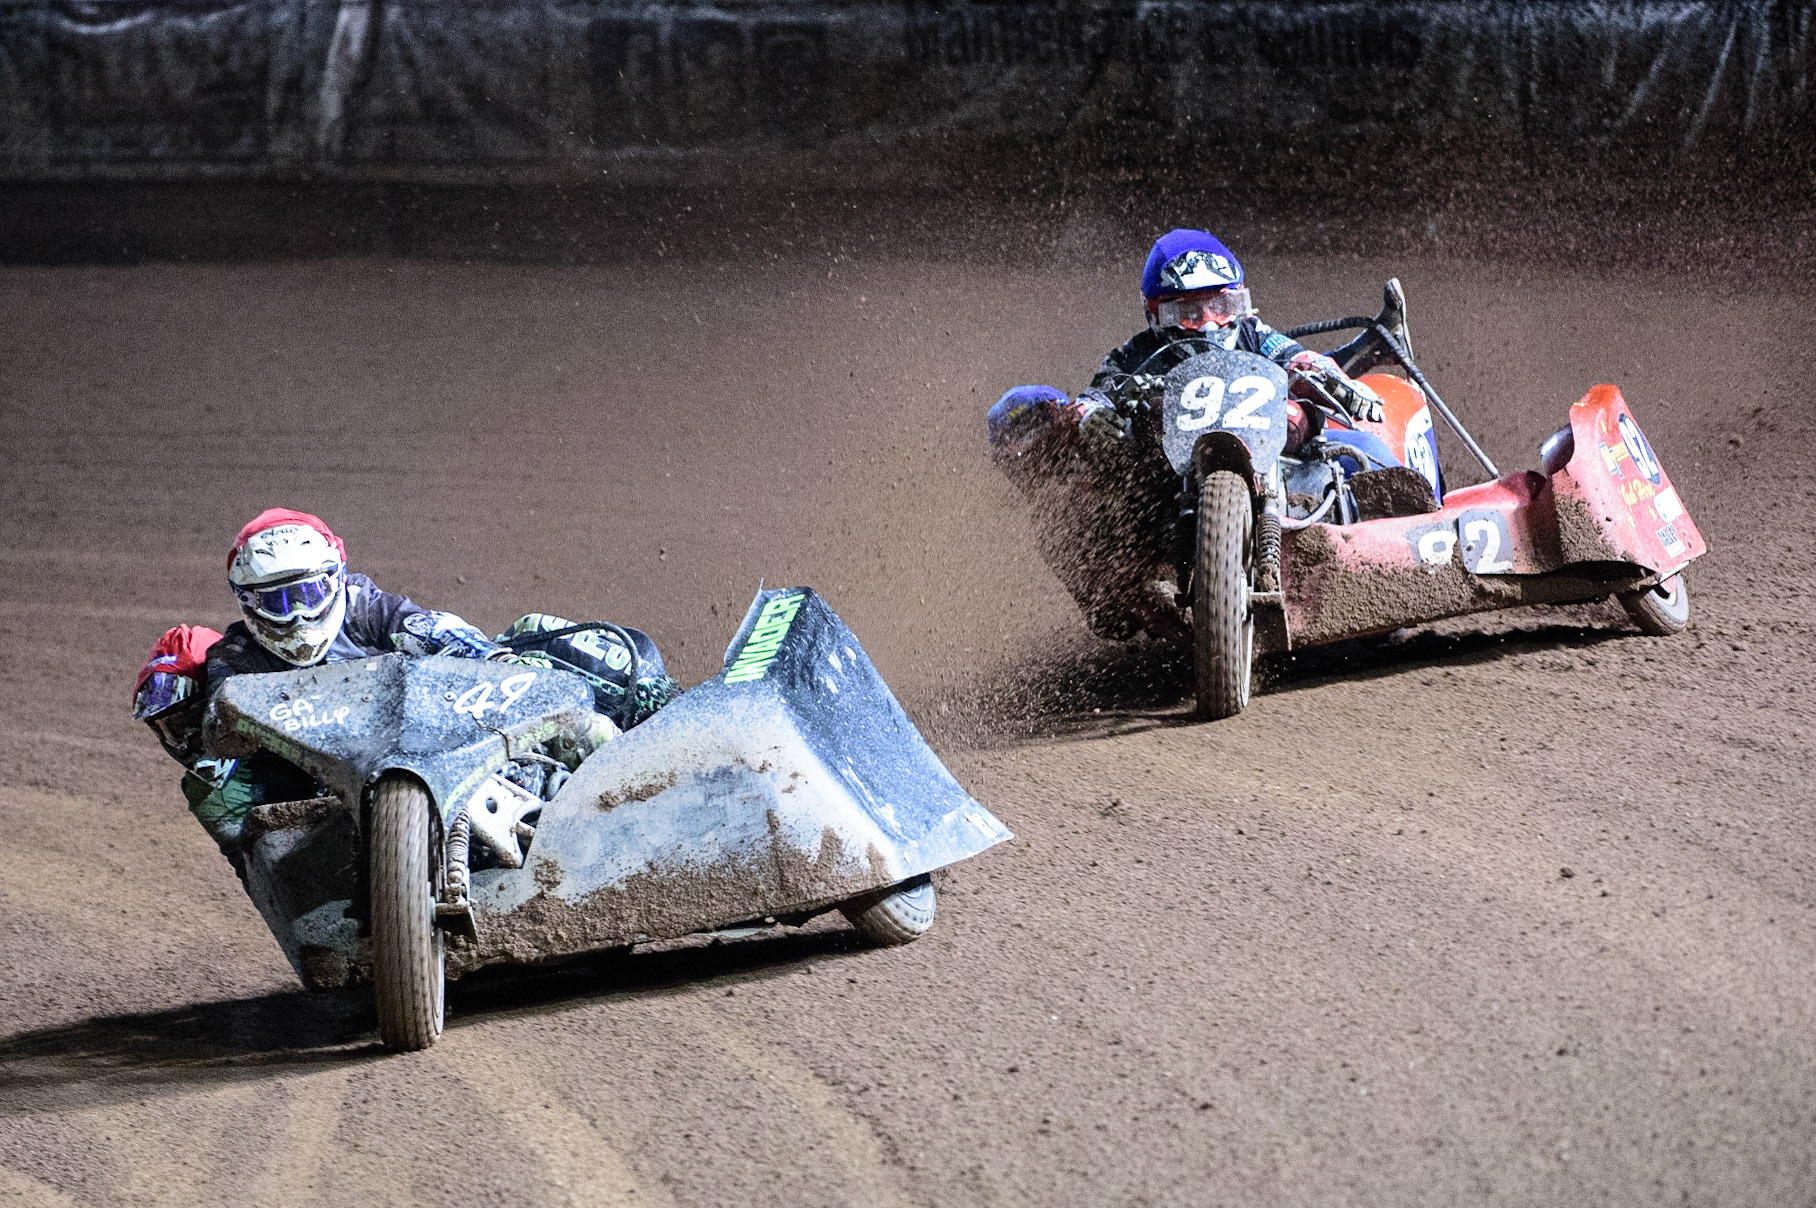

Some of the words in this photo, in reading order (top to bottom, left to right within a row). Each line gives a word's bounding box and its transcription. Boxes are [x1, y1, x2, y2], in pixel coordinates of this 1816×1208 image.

[1176, 375, 1276, 432] 92
[723, 593, 806, 684] INVADER
[452, 671, 538, 719] 49
